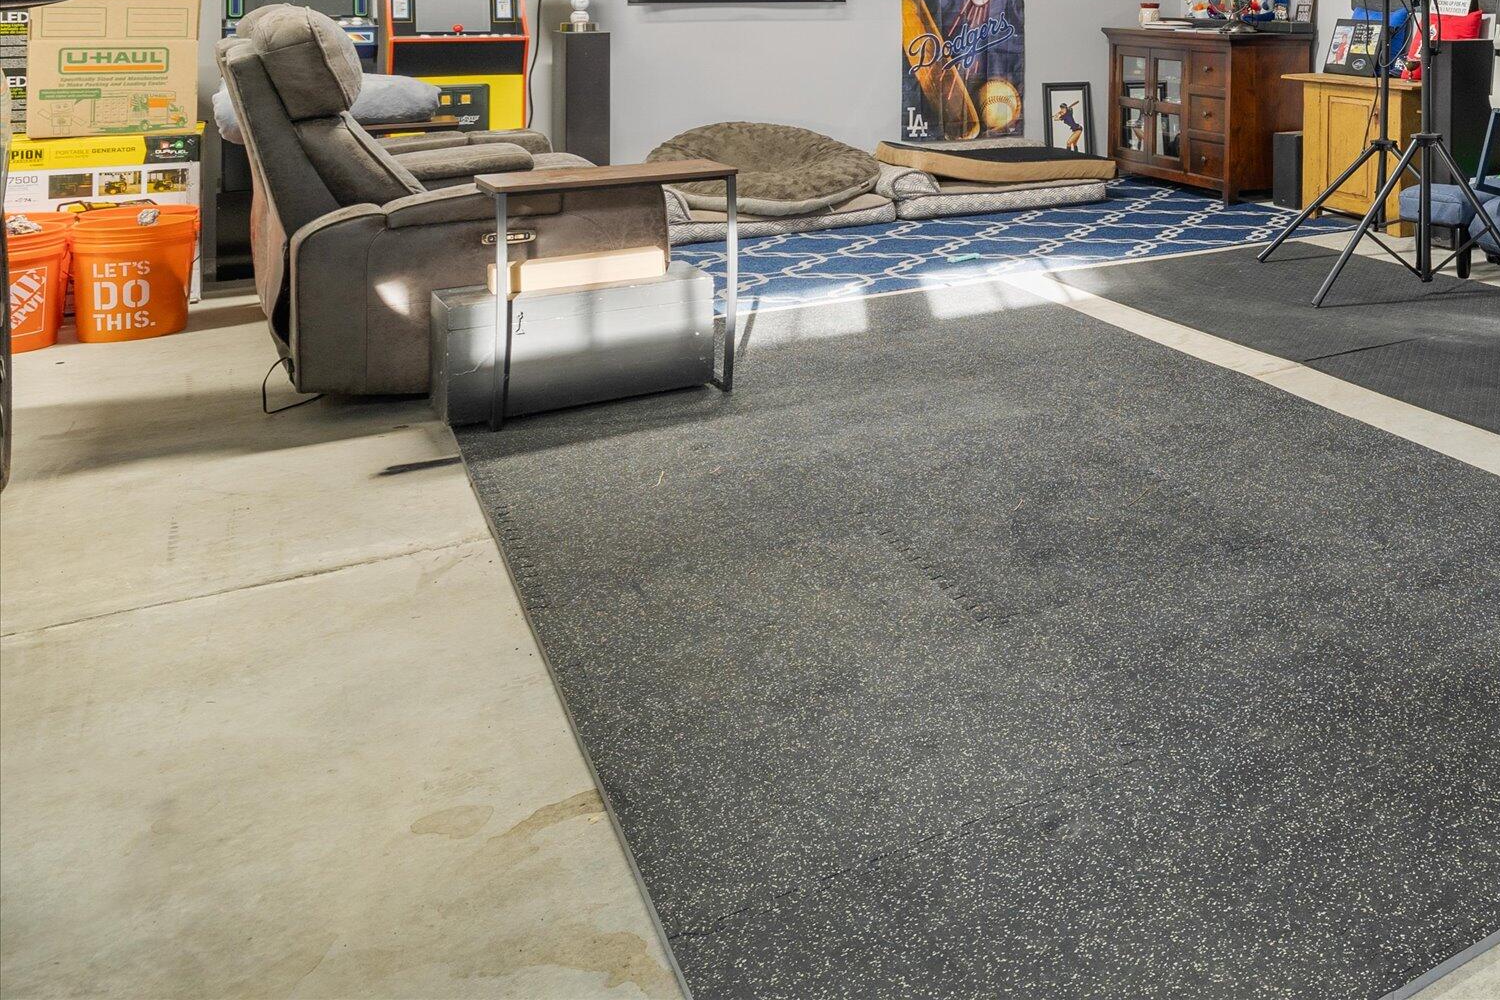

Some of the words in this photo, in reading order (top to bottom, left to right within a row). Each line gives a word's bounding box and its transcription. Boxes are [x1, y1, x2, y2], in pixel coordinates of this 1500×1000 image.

[909, 12, 1015, 75] Dodgers
[66, 51, 162, 64] U-HAUL
[7, 76, 26, 87] ED
[906, 106, 928, 138] LA
[11, 149, 43, 160] PION
[91, 146, 136, 154] GENERATOR
[8, 175, 38, 185] 7500
[92, 260, 151, 279] LET'S
[93, 279, 150, 311] DO
[11, 291, 44, 330] EPOT
[92, 310, 157, 331] THIS.
